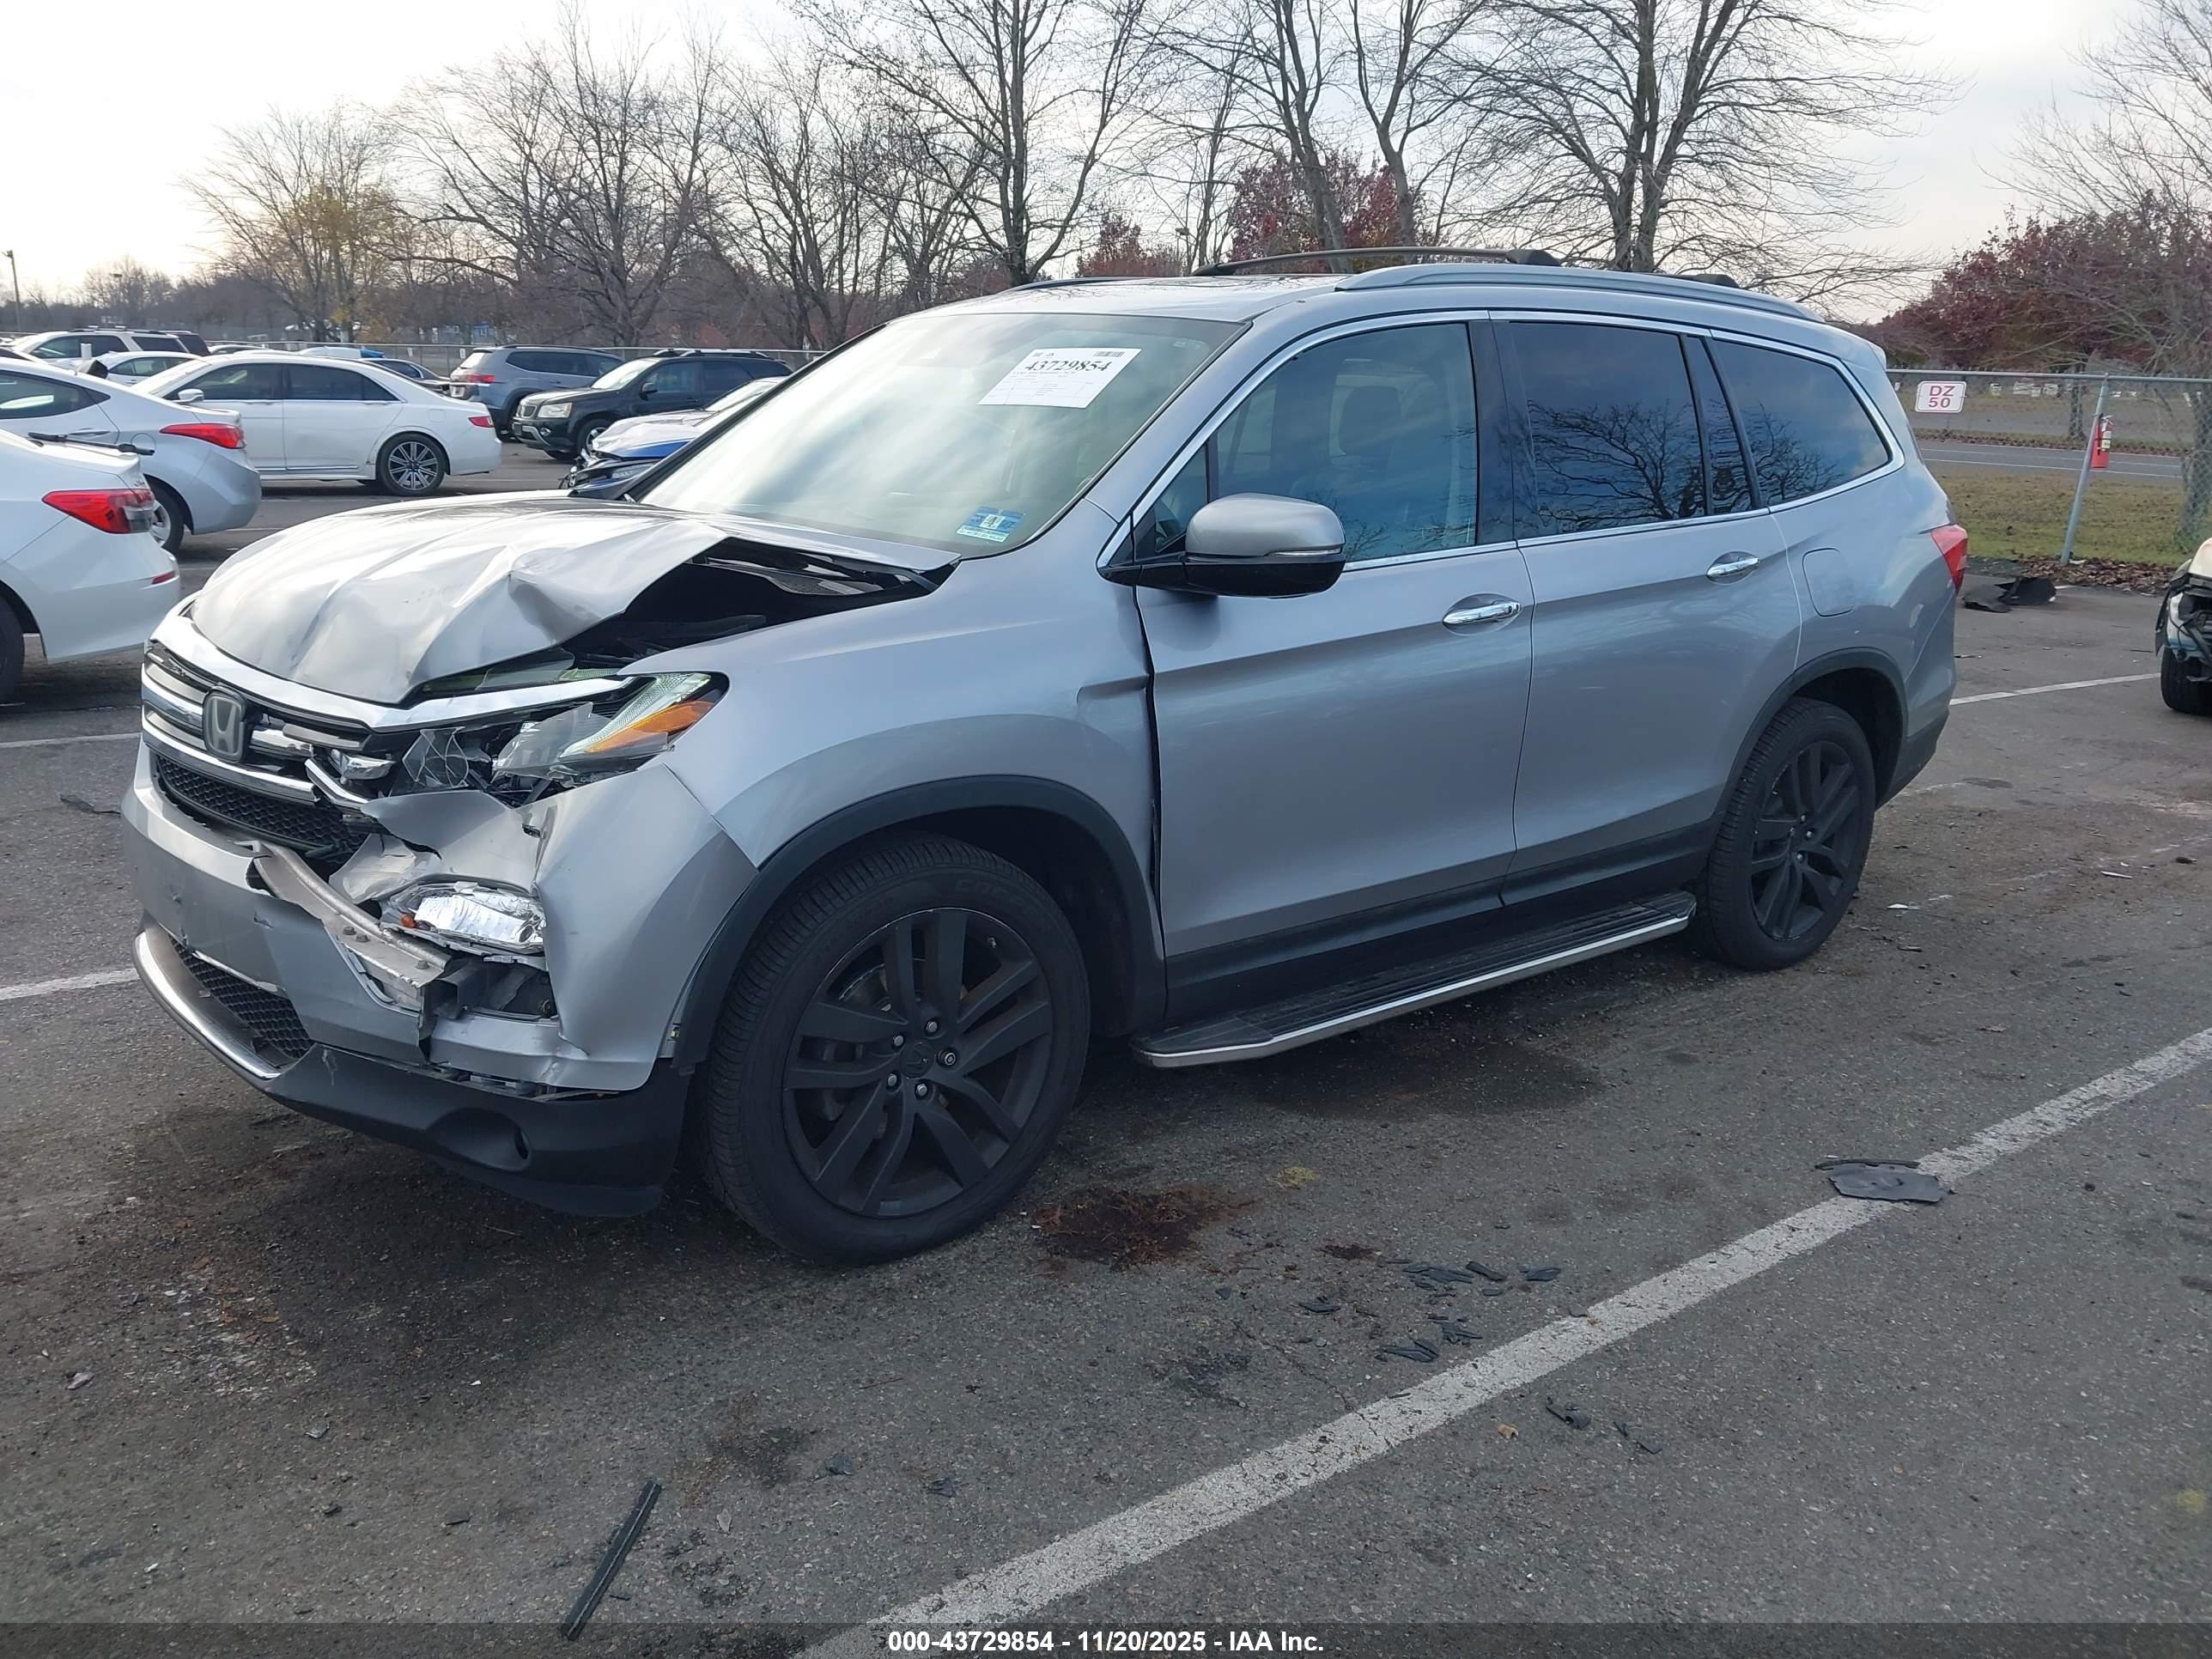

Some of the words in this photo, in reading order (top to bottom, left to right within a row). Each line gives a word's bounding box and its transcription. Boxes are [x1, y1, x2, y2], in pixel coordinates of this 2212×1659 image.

[1024, 360, 1113, 372] 43729854
[1929, 385, 1954, 397] DZ
[1928, 397, 1951, 409] 50
